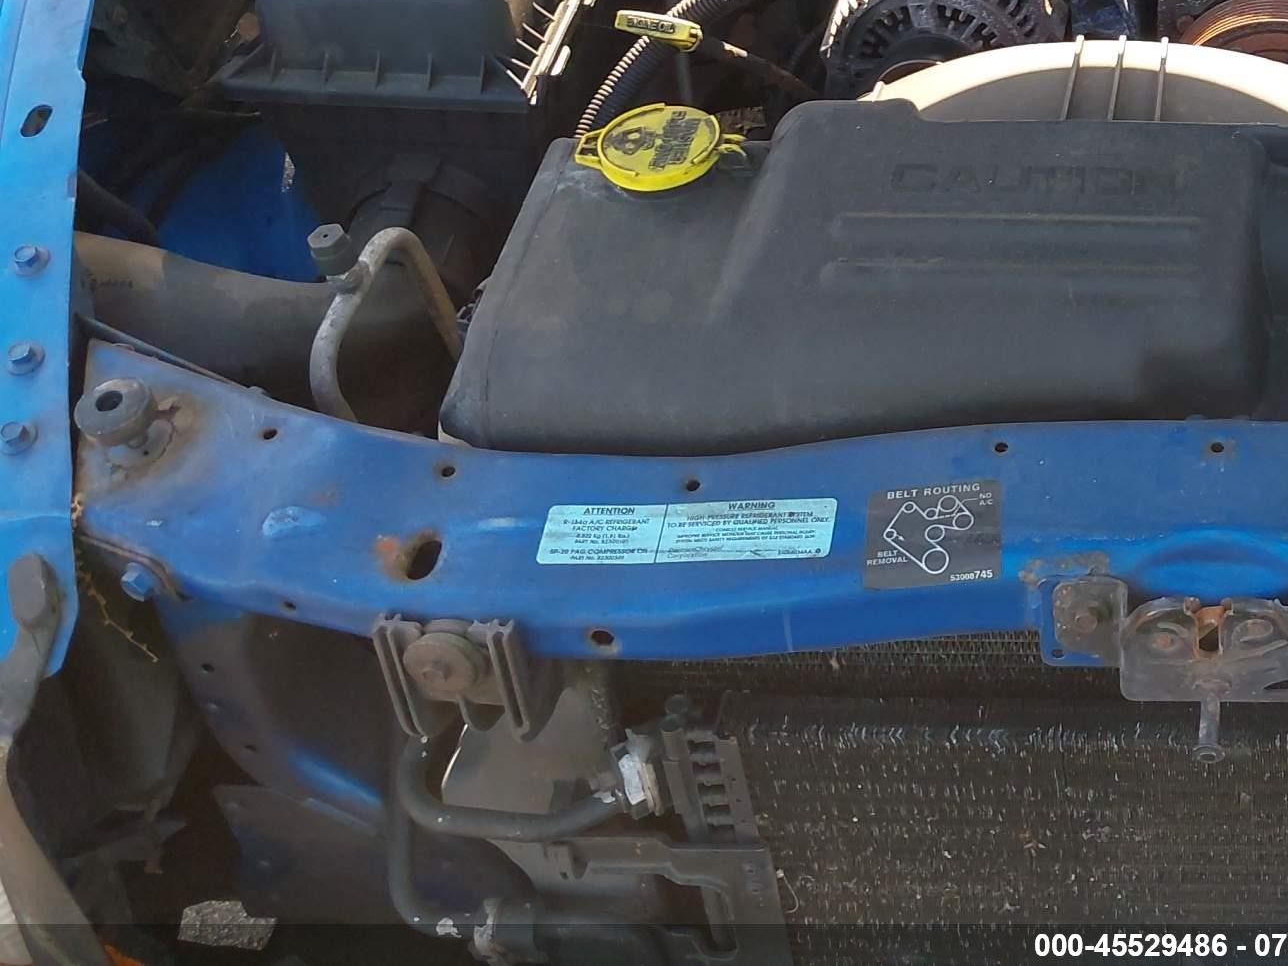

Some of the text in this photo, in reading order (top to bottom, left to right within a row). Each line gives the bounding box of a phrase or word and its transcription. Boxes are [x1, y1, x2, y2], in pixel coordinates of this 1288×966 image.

[887, 482, 981, 500] BELT ROUTING
[583, 507, 635, 515] ATTENTION
[728, 502, 775, 511] WARNING
[877, 549, 899, 558] BELT
[866, 556, 909, 566] REMOVAL
